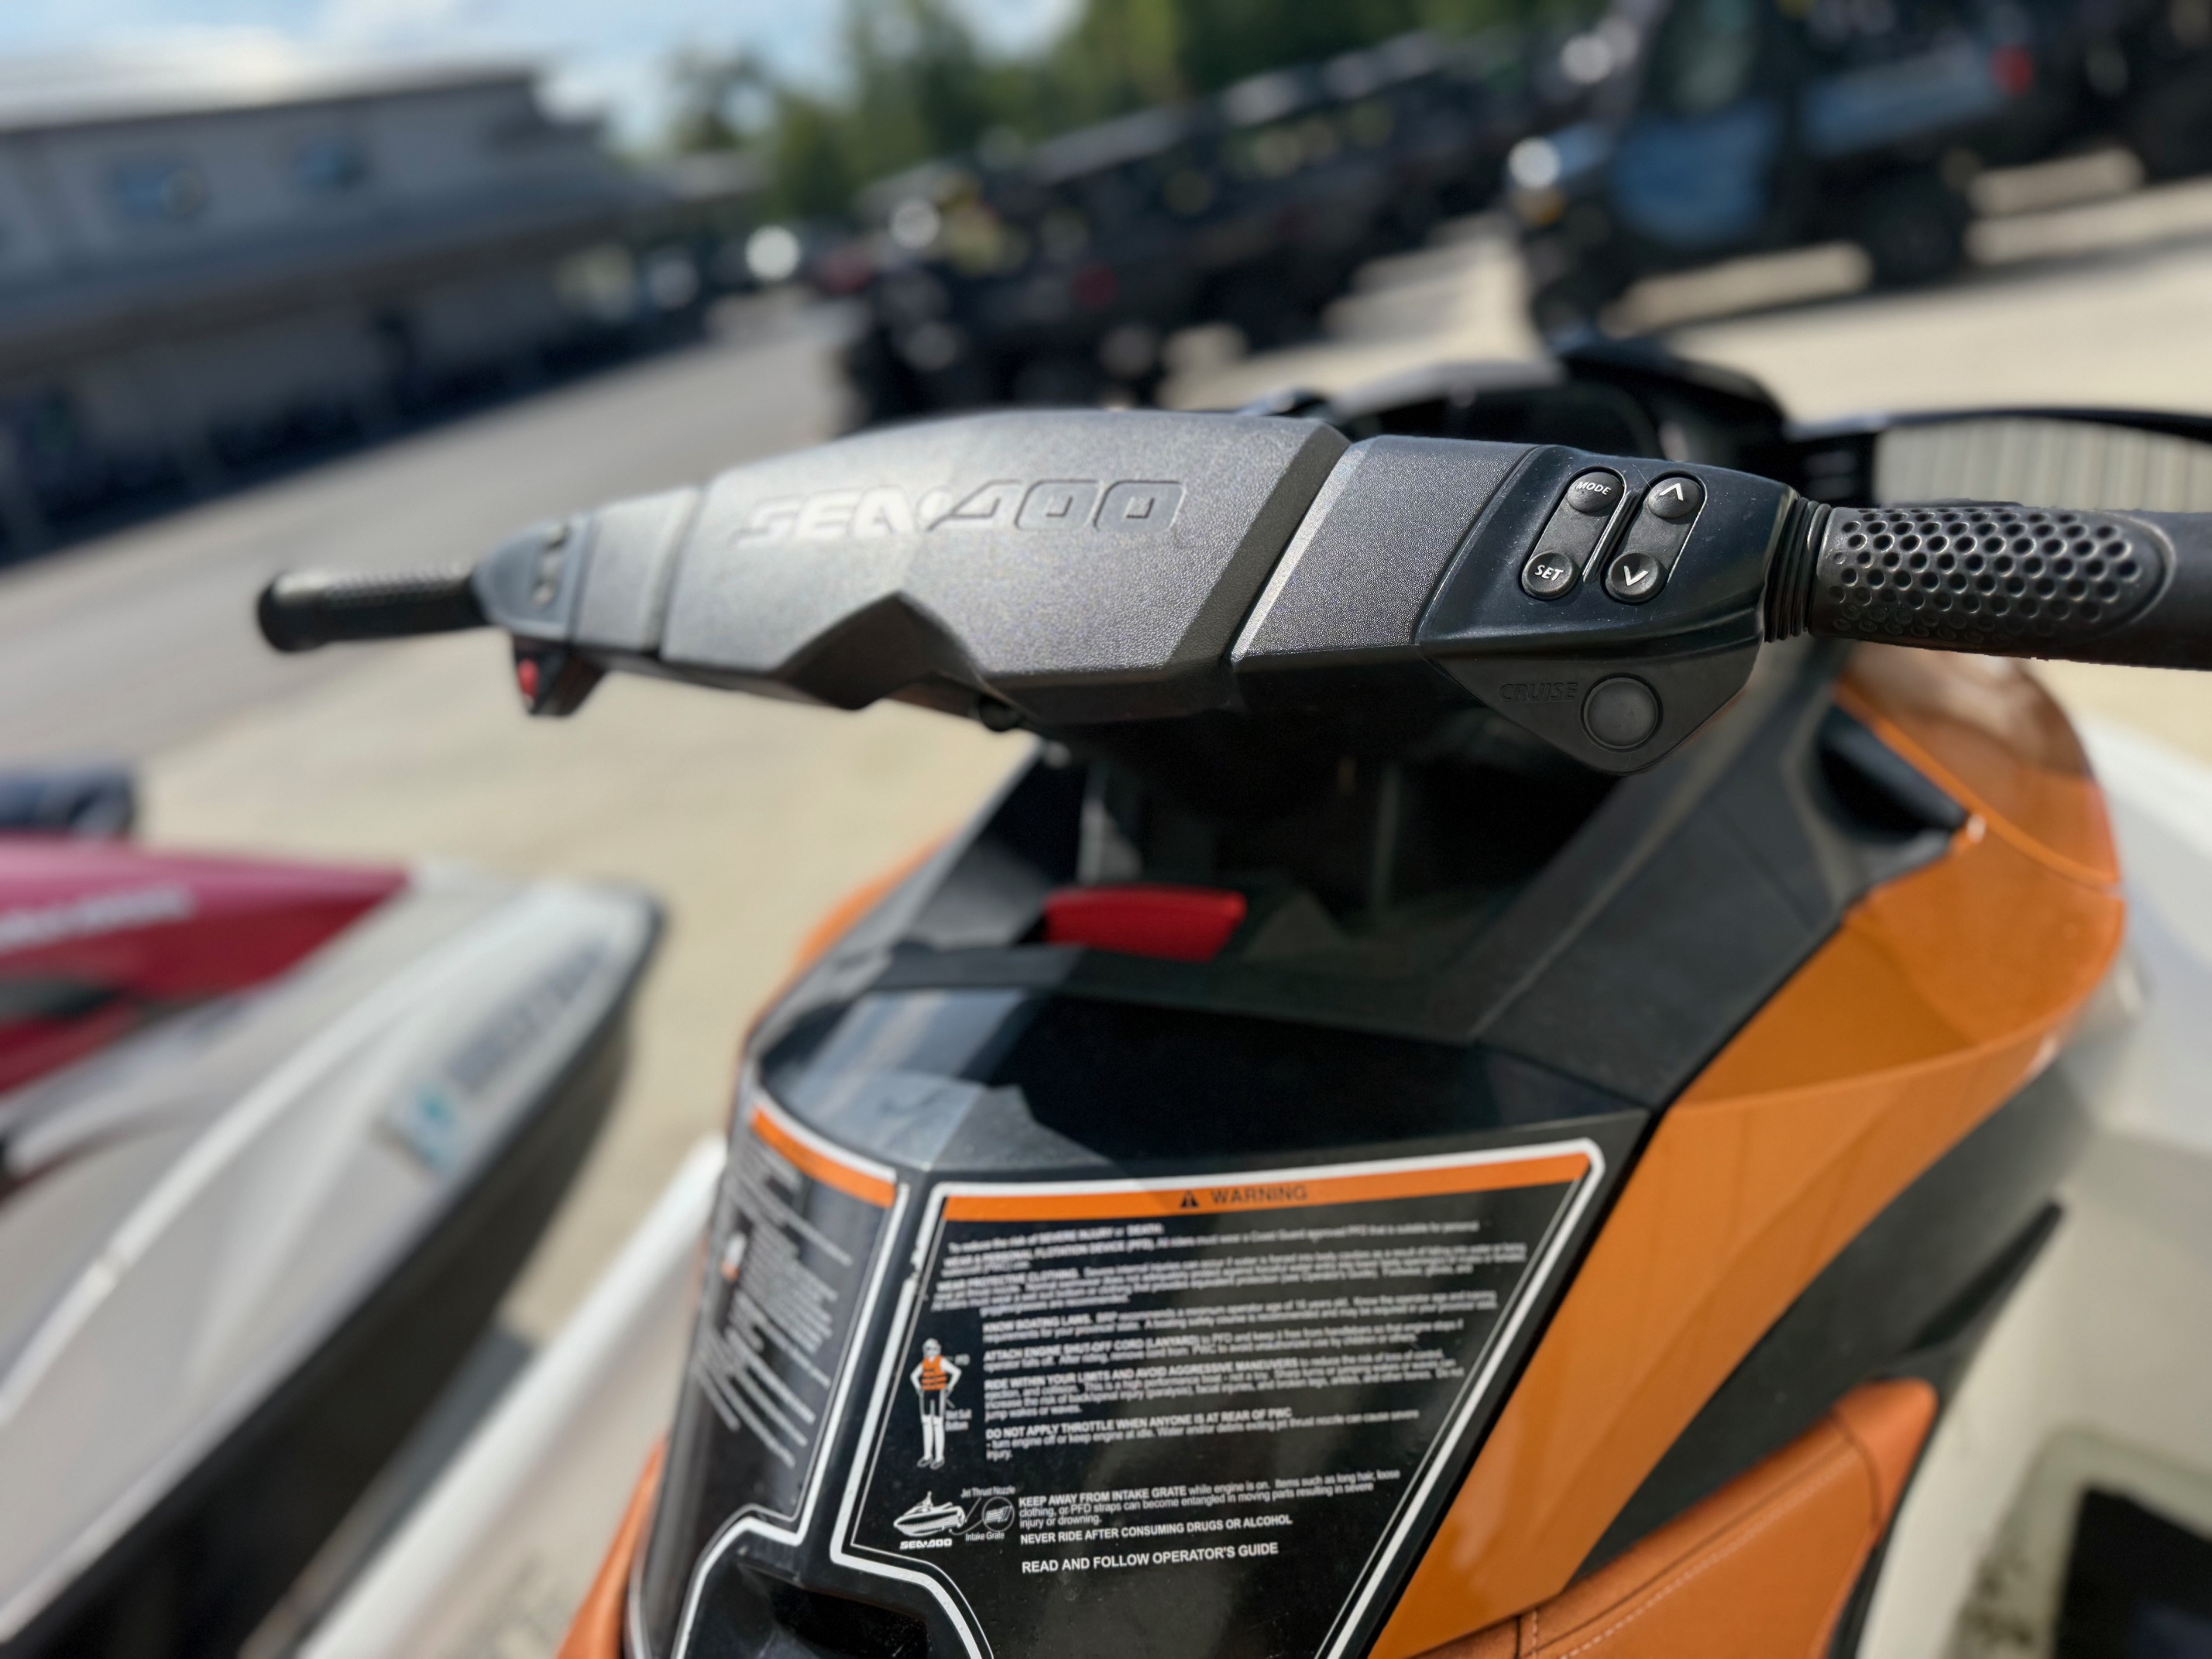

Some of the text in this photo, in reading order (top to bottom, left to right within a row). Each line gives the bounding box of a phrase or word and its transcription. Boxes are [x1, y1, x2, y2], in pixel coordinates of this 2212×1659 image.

[1576, 480, 1612, 496] MODE
[1534, 565, 1564, 582] SET
[1499, 682, 1578, 702] CRUISE
[1211, 1184, 1307, 1205] WARNING
[985, 1406, 1293, 1441] DO NOT APPLY THROTTLE WHEN ANYONE IS AT REAR OF PWC
[972, 1487, 992, 1497] Thrust
[1018, 1496, 1046, 1508] KEEP
[1048, 1492, 1078, 1506] AWAY
[1079, 1490, 1110, 1503] FROM
[1111, 1487, 1149, 1501] INTAKE
[1151, 1485, 1187, 1498] GRATE
[1188, 1482, 1212, 1495] while
[1214, 1480, 1245, 1496] engine
[1245, 1479, 1254, 1491] is
[1275, 1475, 1300, 1489] Items
[1301, 1474, 1323, 1486] such
[1324, 1475, 1335, 1485] as
[1336, 1472, 1355, 1486] long
[1376, 1468, 1400, 1481] loose
[1058, 1506, 1069, 1515] or
[1070, 1503, 1091, 1514] PFD
[1093, 1501, 1121, 1515] straps
[1123, 1501, 1141, 1510] can
[1142, 1497, 1179, 1509] become
[1181, 1493, 1225, 1508] entangled
[1227, 1492, 1236, 1503] in
[1238, 1489, 1270, 1504] moving
[1272, 1488, 1294, 1501] parts
[1296, 1485, 1333, 1499] resulting
[1334, 1484, 1343, 1494] in
[1345, 1483, 1374, 1493] severe
[1019, 1517, 1044, 1530] injury
[1057, 1513, 1101, 1527] drowning.
[1020, 1532, 1056, 1546] NEVER
[1058, 1530, 1083, 1543] RIDE
[1084, 1527, 1119, 1540] AFTER
[1121, 1522, 1184, 1538] CONSUMING
[1187, 1519, 1223, 1533] DRUGS
[1225, 1517, 1242, 1530] OR
[965, 1530, 1005, 1541] Intake Grate
[1022, 1542, 1279, 1575] READ AND FOLLOW OPERATOR'S GUIDE
